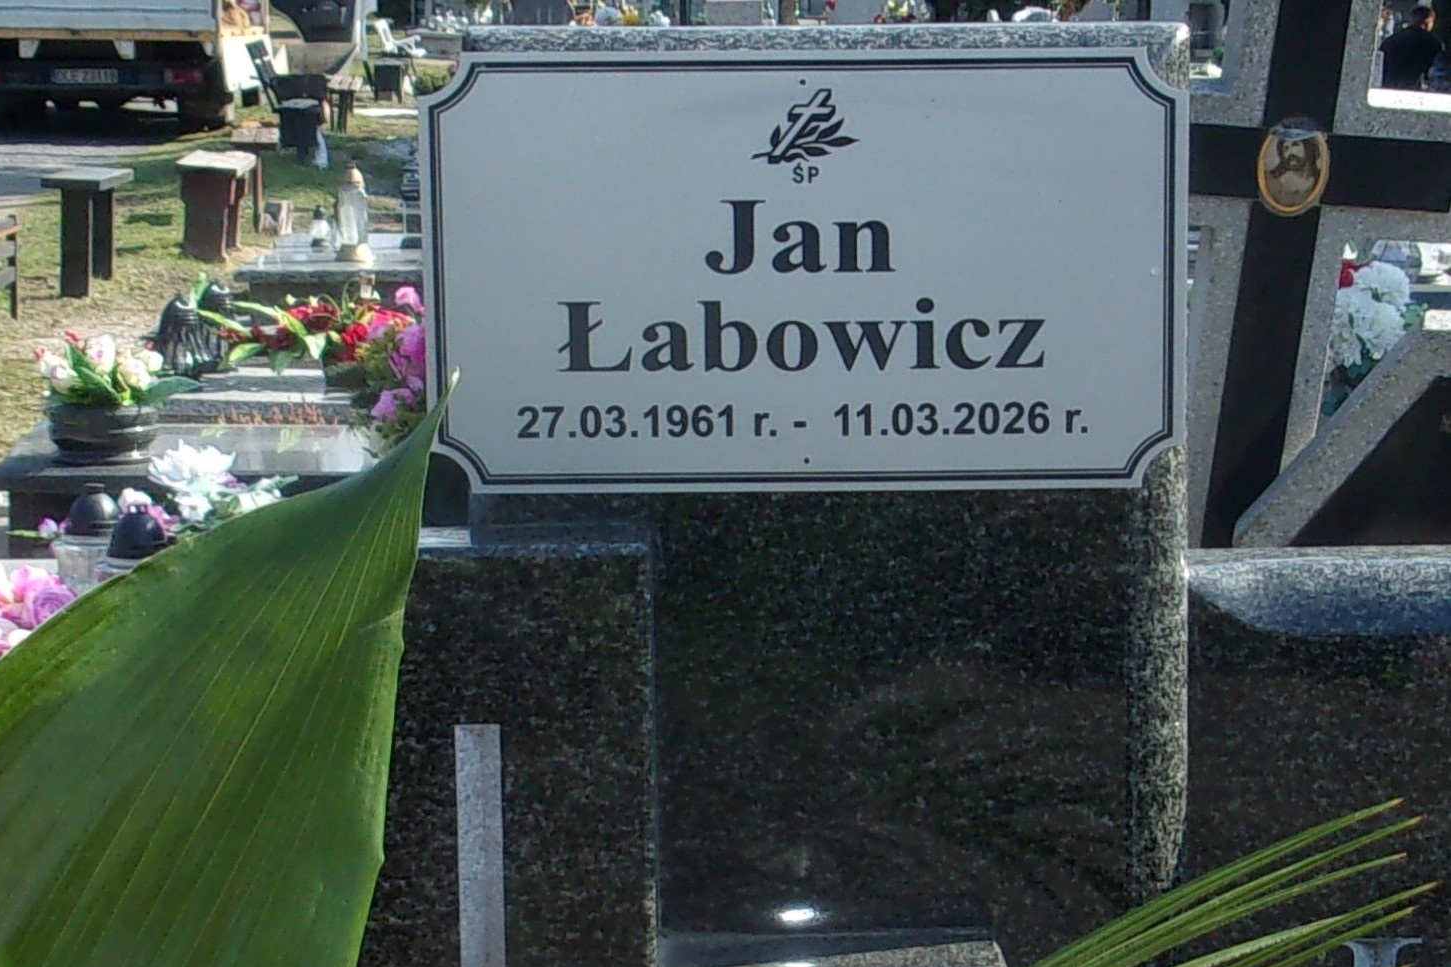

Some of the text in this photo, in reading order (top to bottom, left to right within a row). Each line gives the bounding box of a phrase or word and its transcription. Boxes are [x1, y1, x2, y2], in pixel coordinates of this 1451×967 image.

[792, 162, 819, 184] ŚP
[704, 199, 896, 275] Jan
[556, 297, 1046, 373] Łabowicz
[517, 404, 735, 439] 27.03.1961
[753, 411, 778, 438] r.
[833, 401, 1051, 437] 11.03.2026
[1065, 408, 1089, 434] r.
